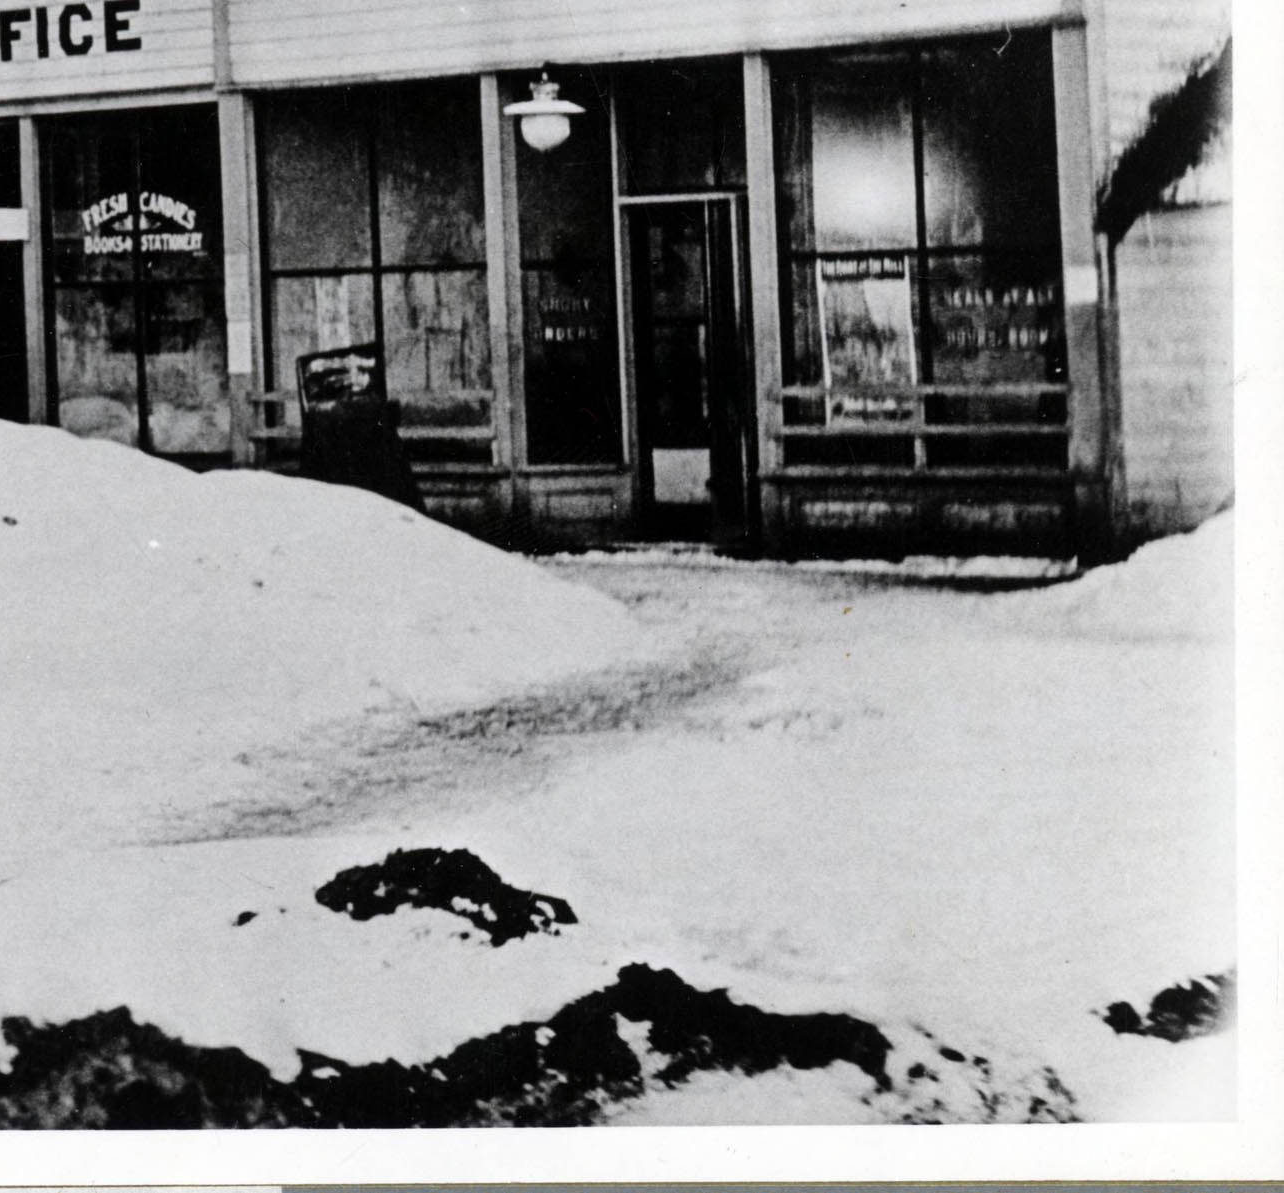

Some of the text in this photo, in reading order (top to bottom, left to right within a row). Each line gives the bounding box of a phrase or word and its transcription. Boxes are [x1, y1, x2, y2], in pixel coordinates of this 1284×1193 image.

[81, 191, 197, 233] FRESH CANDIES
[83, 235, 123, 255] BOOKS
